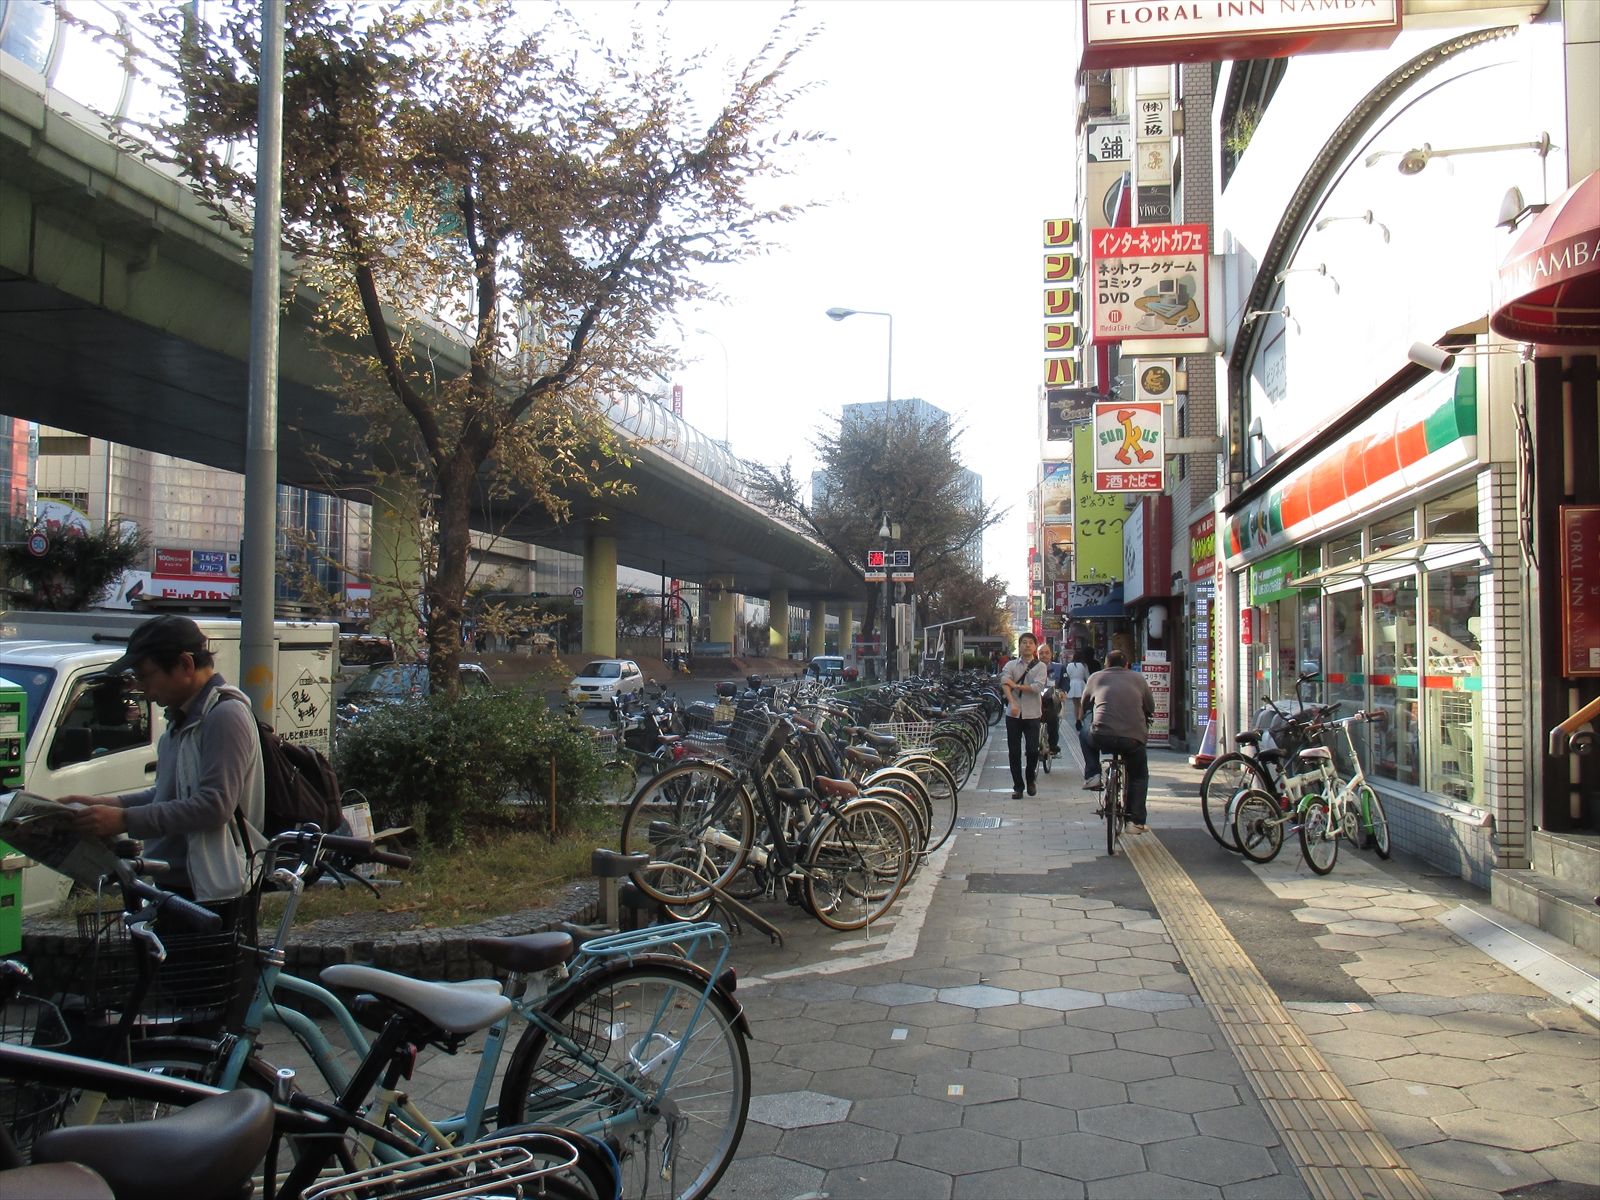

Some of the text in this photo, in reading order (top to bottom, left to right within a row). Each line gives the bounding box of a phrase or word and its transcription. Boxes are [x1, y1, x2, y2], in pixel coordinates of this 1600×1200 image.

[1106, 4, 1203, 25] FLORAL
[1217, 1, 1265, 18] INN
[1098, 229, 1203, 254] インターネットカフェ
[1098, 260, 1197, 277] ネットワークゲーム
[1098, 276, 1142, 289] コミック
[1099, 293, 1130, 305] DVD
[1105, 473, 1158, 489] 酒・たばこ
[33, 539, 44, 550] 50
[1571, 577, 1585, 607] INN
